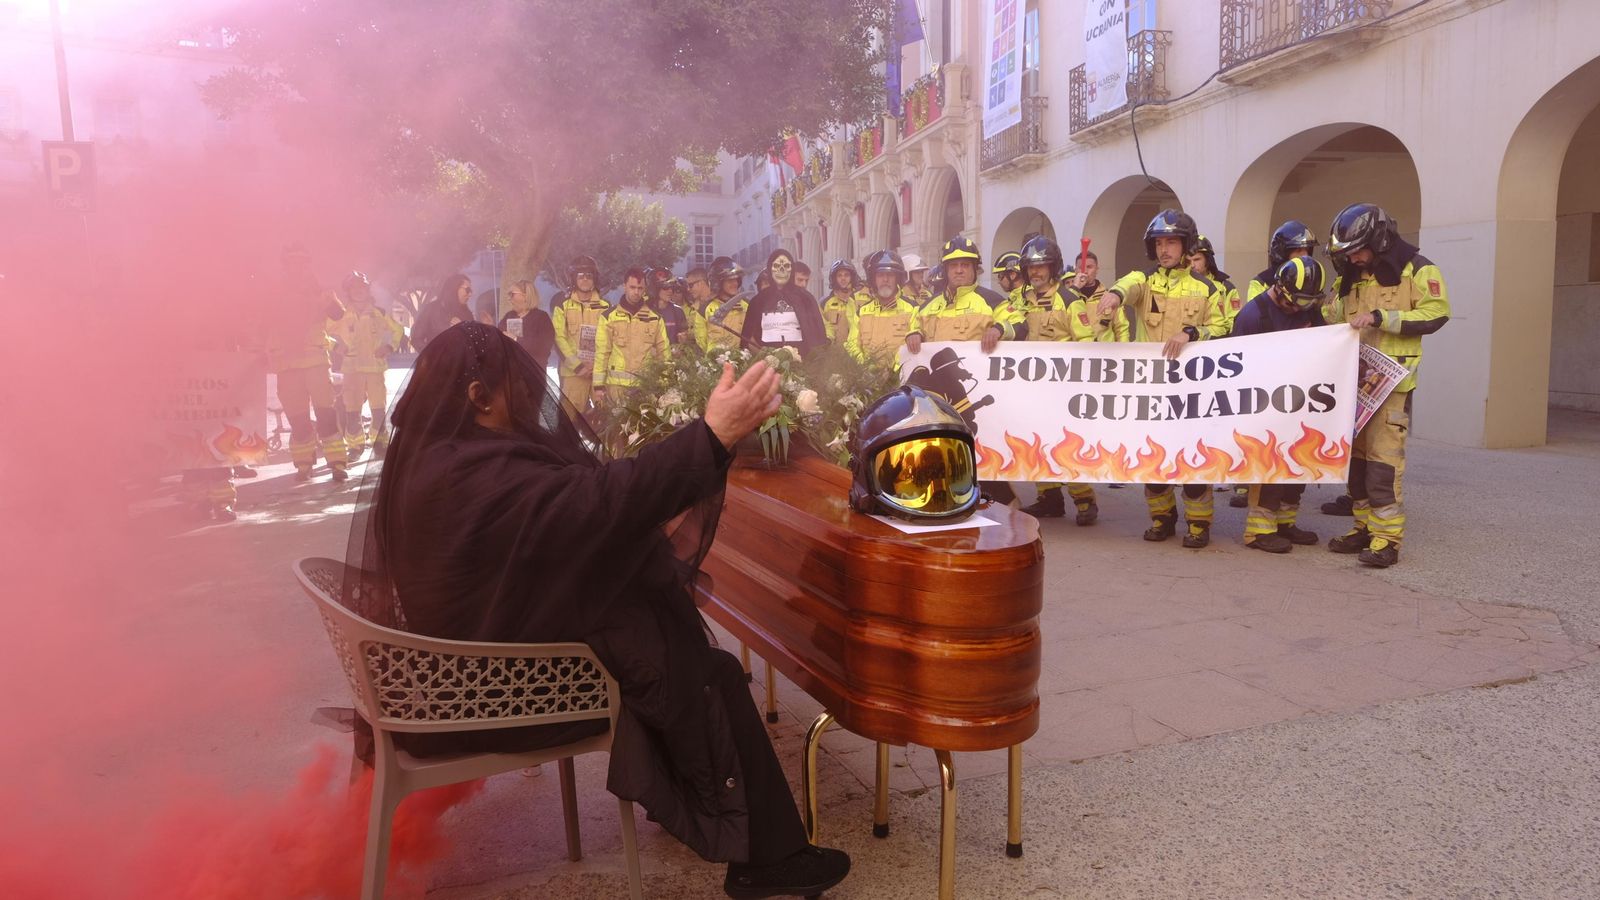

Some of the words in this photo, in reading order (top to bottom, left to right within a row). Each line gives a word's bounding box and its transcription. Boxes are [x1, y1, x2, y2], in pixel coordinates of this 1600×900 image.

[1086, 11, 1123, 42] UCRANIA
[49, 148, 81, 190] P
[987, 352, 1243, 383] BOMBEROS
[1067, 383, 1336, 421] QUEMADOS
